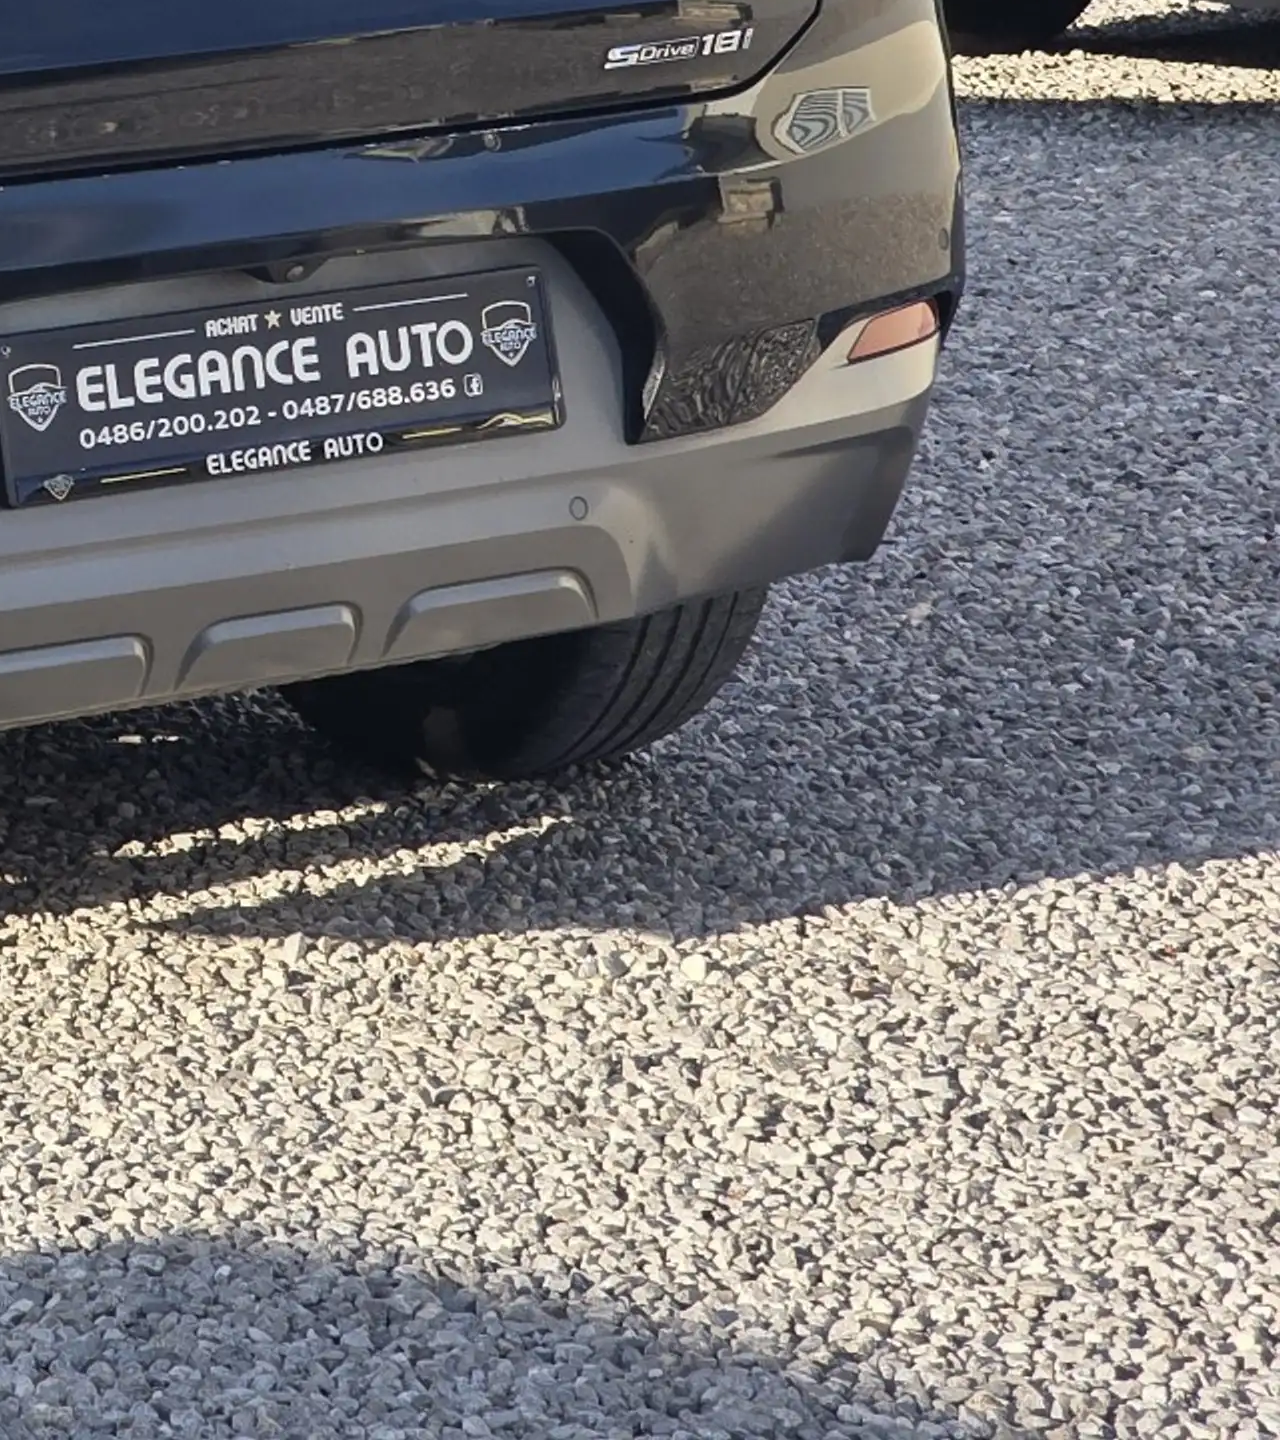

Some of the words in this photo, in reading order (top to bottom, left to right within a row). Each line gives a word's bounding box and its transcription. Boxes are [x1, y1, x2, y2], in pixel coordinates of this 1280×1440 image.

[205, 314, 259, 338] ACHAT
[290, 303, 344, 328] VENTE
[76, 337, 320, 412] ELEGANCE
[346, 320, 474, 379] AUTO
[80, 406, 261, 449] 0486/200.202
[282, 378, 456, 420] 0487/688.636
[206, 440, 312, 476] ELEGANCE
[324, 432, 384, 458] AUTO
